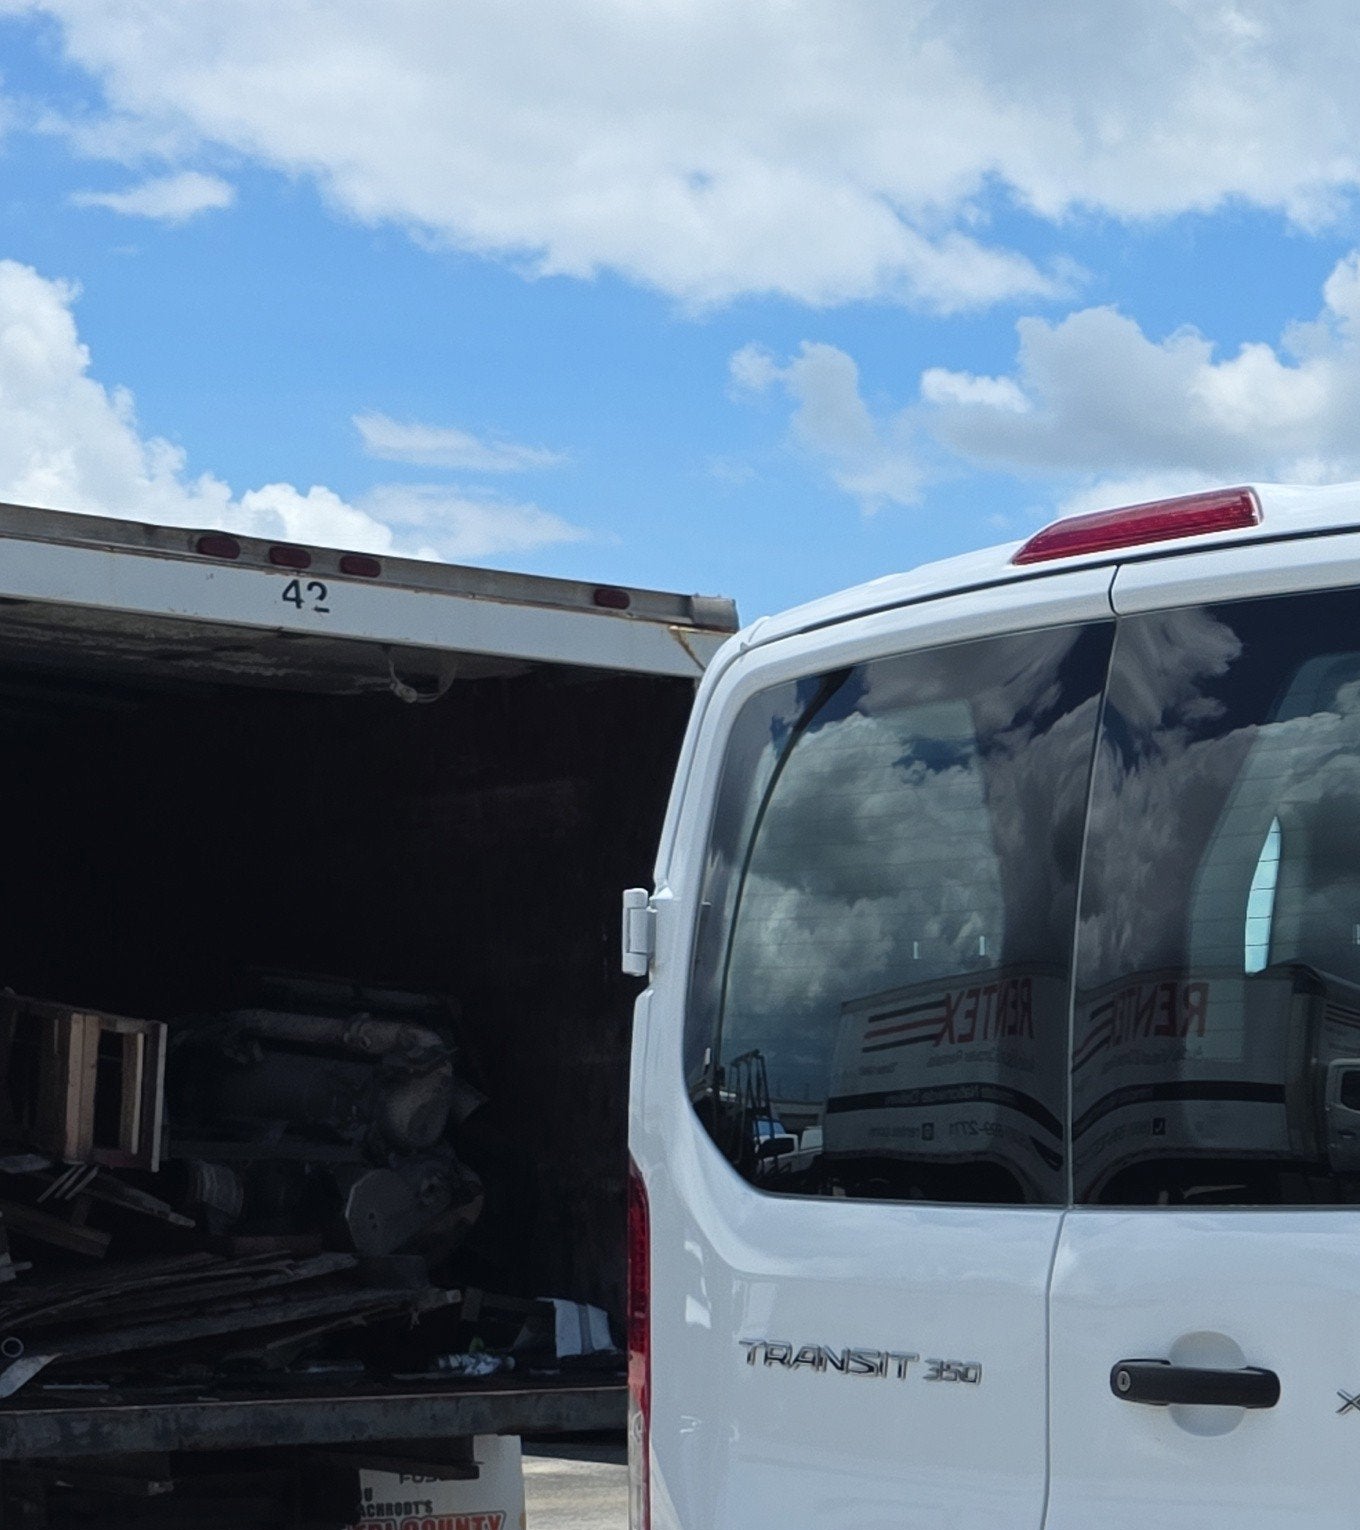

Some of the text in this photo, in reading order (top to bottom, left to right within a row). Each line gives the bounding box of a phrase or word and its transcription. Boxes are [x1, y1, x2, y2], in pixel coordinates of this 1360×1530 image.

[281, 578, 331, 614] 42
[738, 1336, 983, 1386] TRANSIT 350
